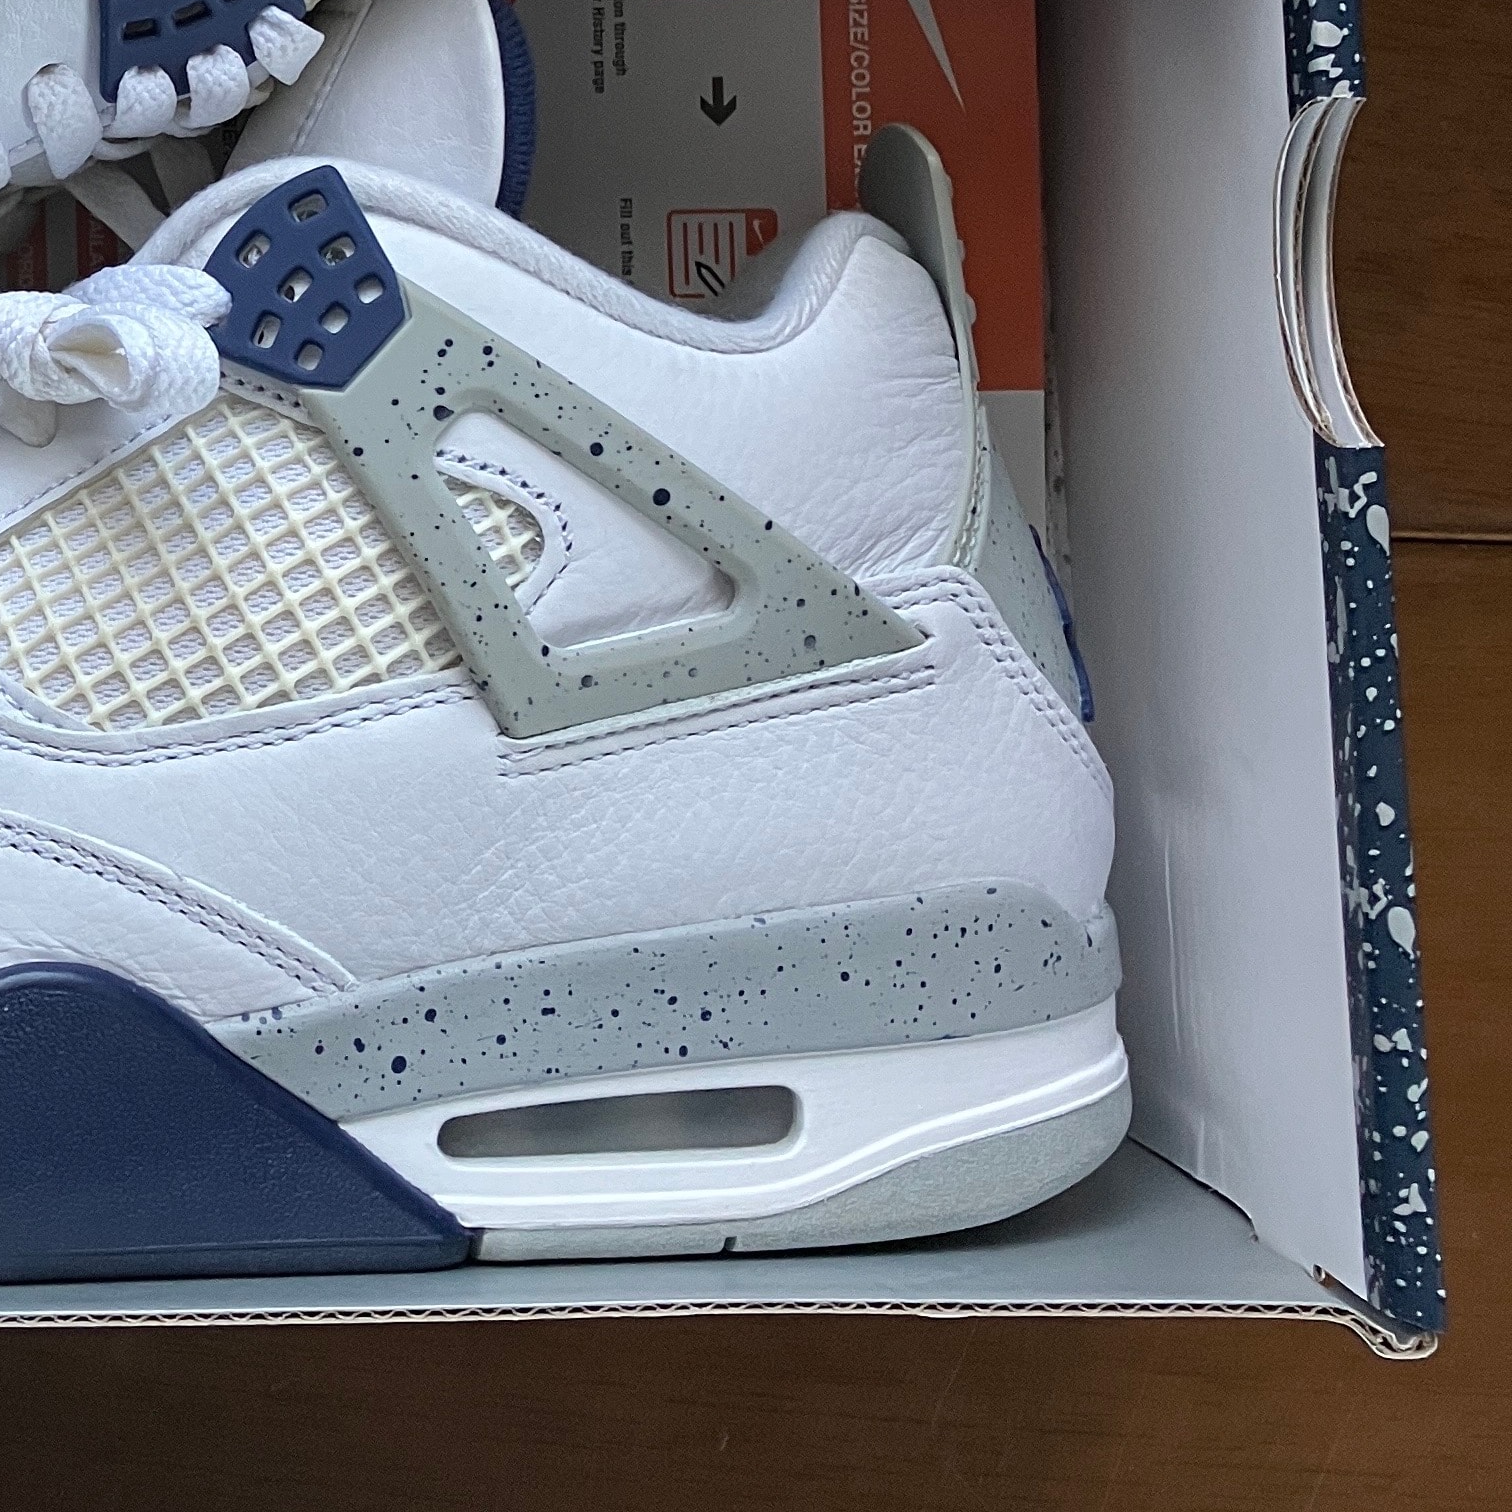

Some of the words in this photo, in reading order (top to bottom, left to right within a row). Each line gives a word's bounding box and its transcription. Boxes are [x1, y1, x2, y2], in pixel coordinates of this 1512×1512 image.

[591, 7, 606, 56] History
[612, 21, 628, 77] through
[591, 60, 606, 94] page
[619, 198, 633, 219] Fill
[620, 222, 633, 246] out
[620, 250, 635, 276] this
